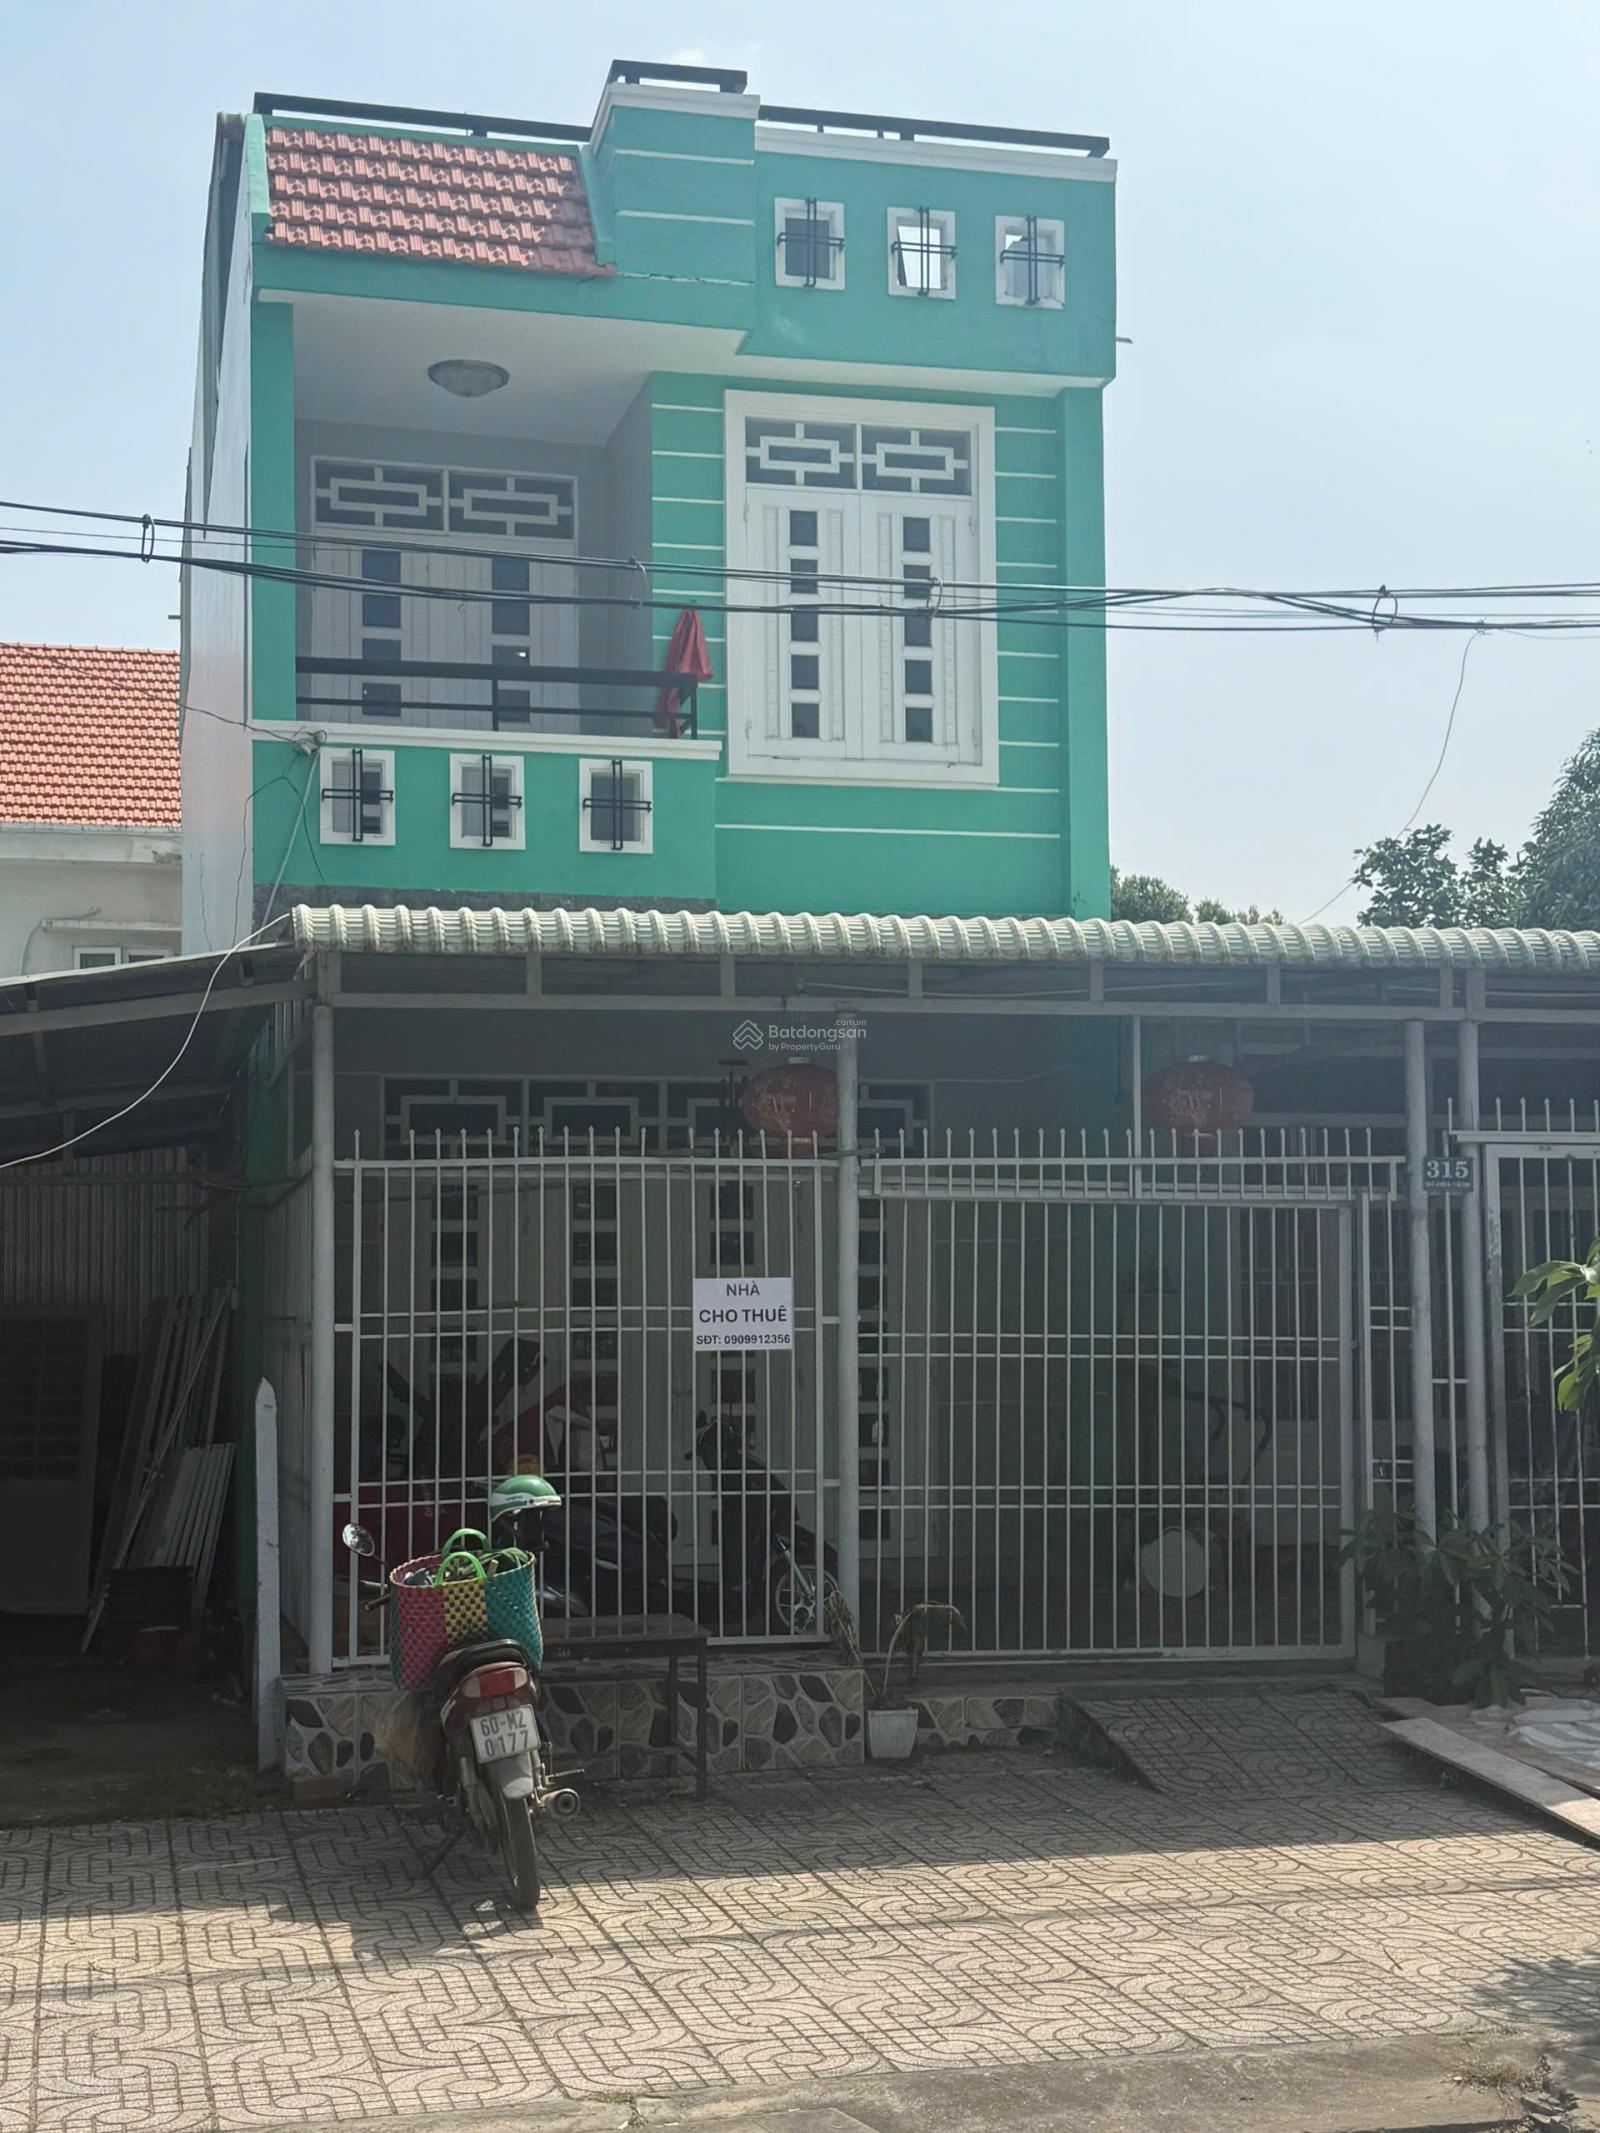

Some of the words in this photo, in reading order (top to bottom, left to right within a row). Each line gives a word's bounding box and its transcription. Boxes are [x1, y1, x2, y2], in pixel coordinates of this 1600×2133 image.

[1427, 1160, 1469, 1178] 315
[727, 1280, 760, 1296] NHÀ
[699, 1309, 738, 1323] CHO
[742, 1305, 787, 1322] THUÊ
[696, 1335, 722, 1345] SĐT:
[724, 1334, 791, 1344] 0909912356
[480, 1710, 527, 1736] 60-M2
[485, 1730, 528, 1757] 0177
